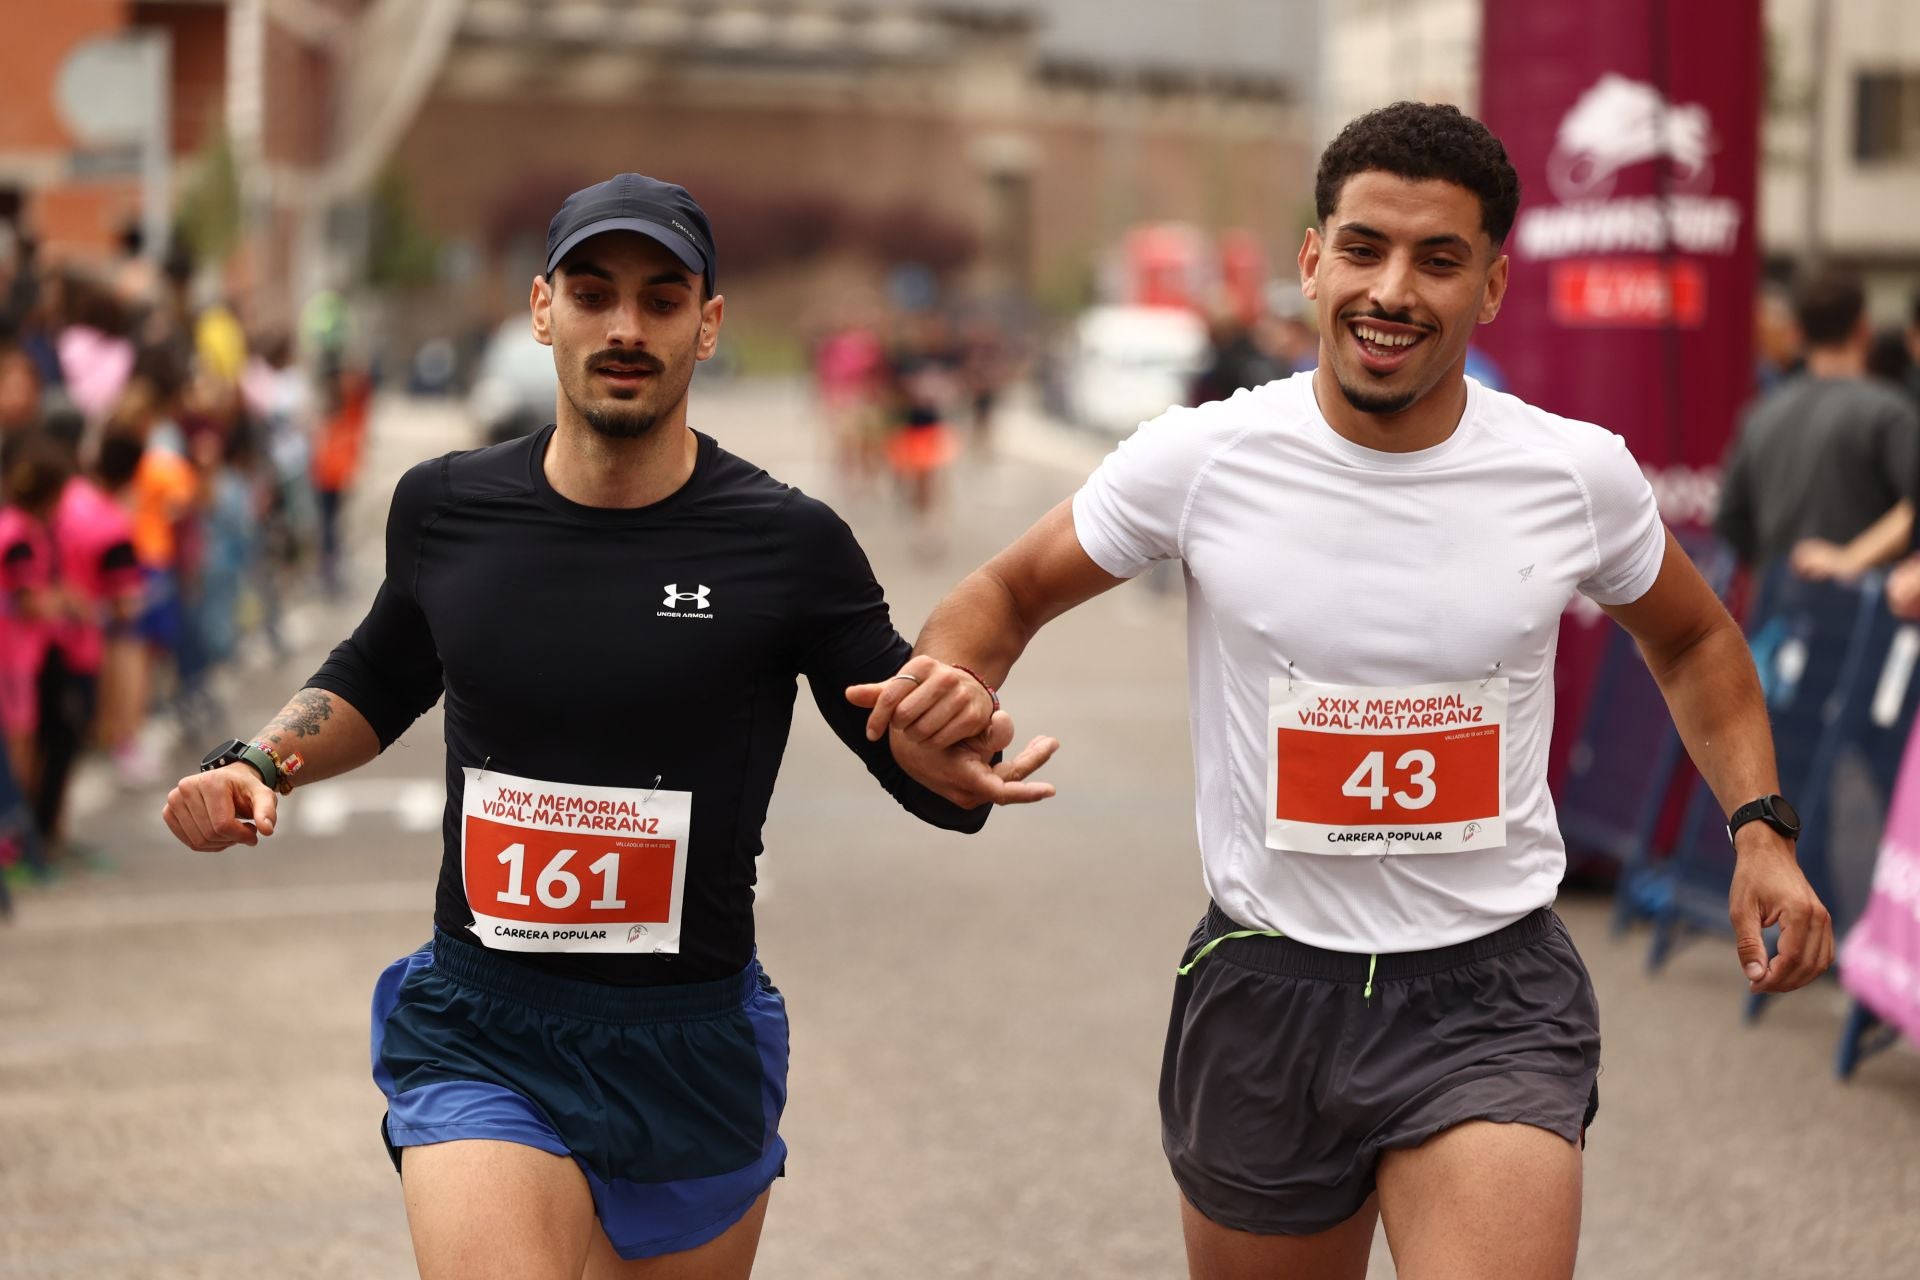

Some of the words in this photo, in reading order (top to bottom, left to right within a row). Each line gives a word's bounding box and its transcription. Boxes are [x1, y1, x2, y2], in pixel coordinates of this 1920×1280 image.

[1298, 706, 1483, 730] VIDAL-MATARRANZ
[1317, 696, 1360, 713] XXIX
[1365, 693, 1464, 716] MEMORIAL
[1342, 749, 1437, 810] 43
[498, 787, 533, 807] XXIX
[537, 794, 640, 818] MEMORIAL
[482, 799, 660, 835] VIDAL-MATARRANZ
[1327, 832, 1384, 843] CARRERA
[1387, 831, 1443, 842] POPULAR
[496, 842, 626, 910] 161
[494, 926, 550, 940] CARRERA
[552, 929, 607, 941] POPULAR
